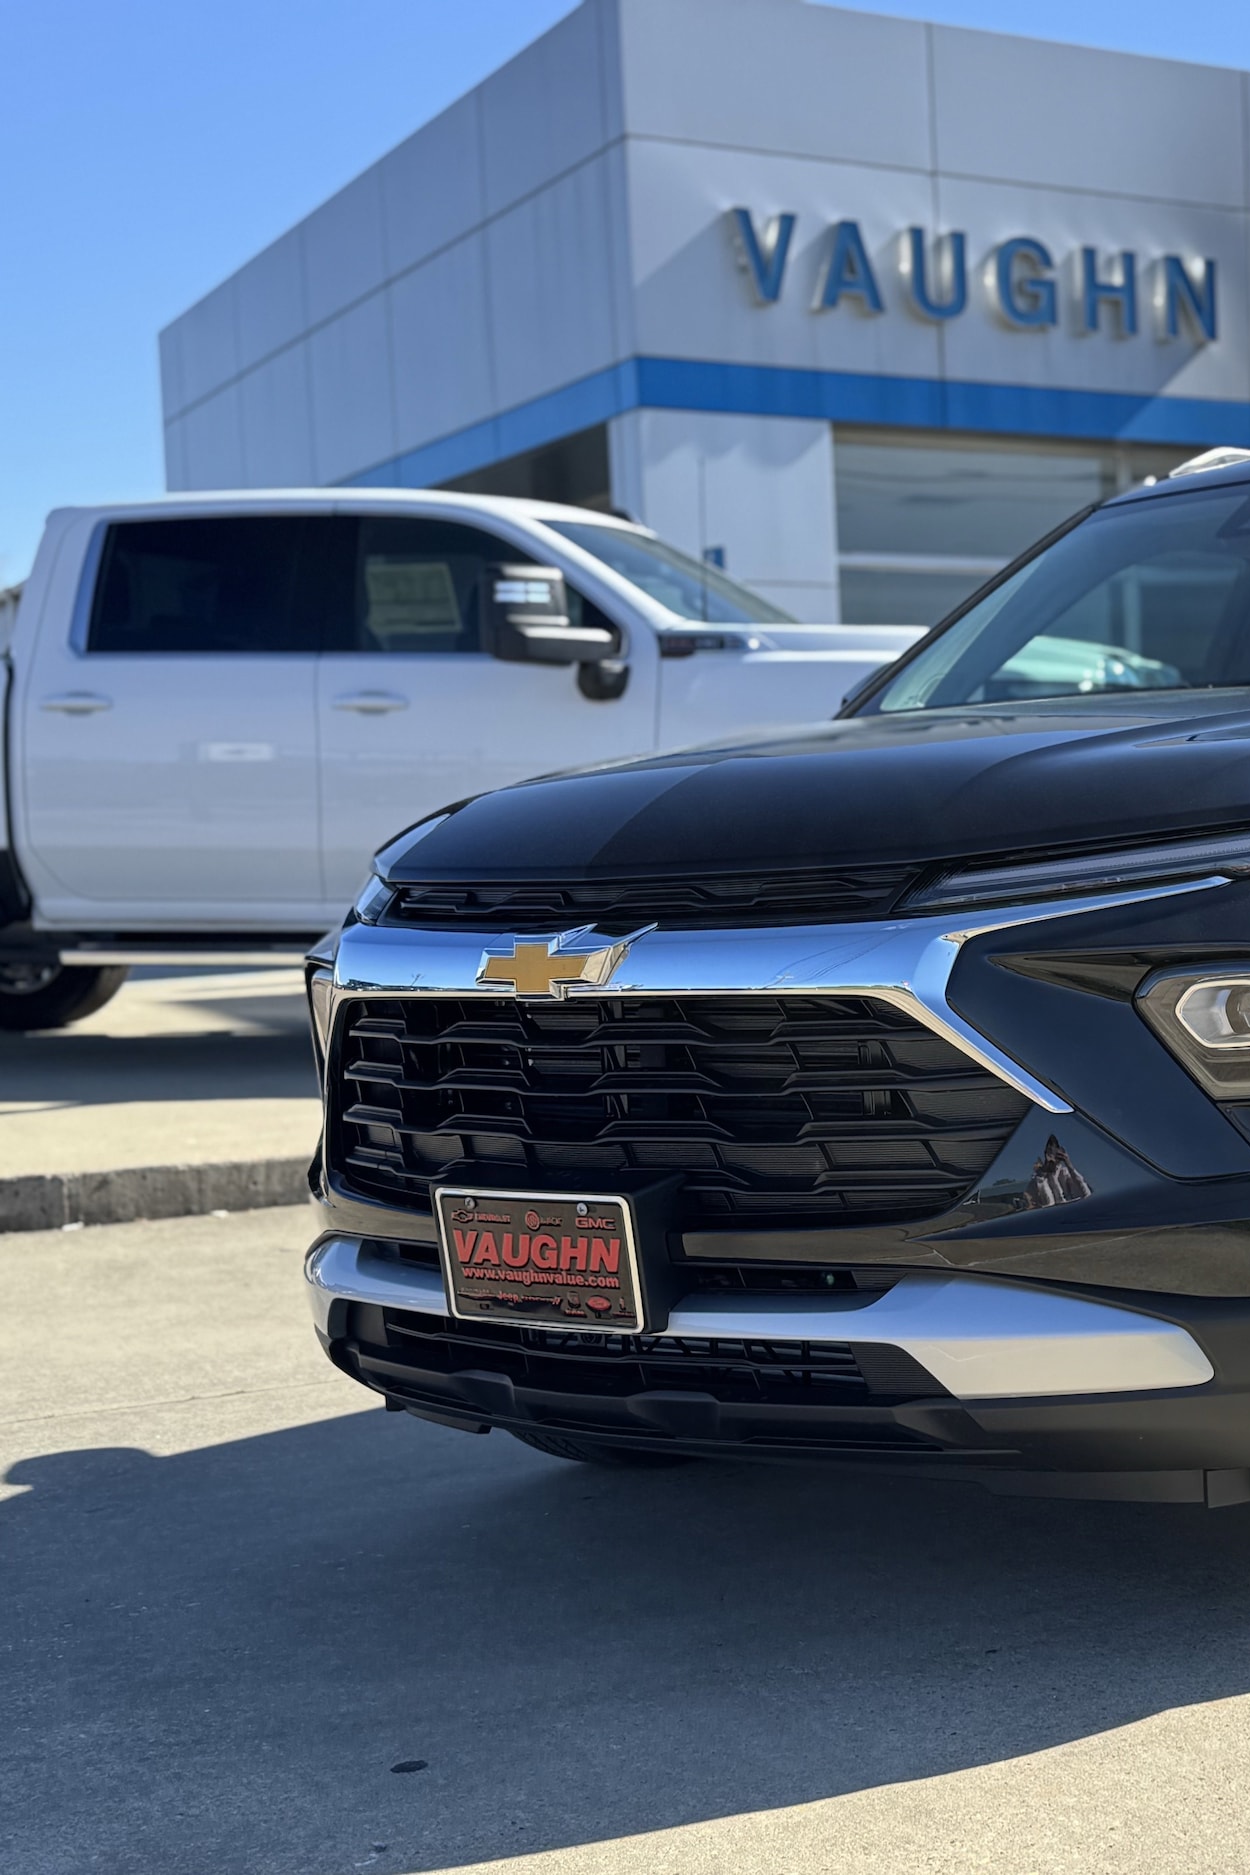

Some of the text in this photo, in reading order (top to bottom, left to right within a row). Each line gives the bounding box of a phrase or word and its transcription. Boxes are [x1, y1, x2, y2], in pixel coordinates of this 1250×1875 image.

[730, 207, 1218, 342] VAUGHN
[575, 1217, 616, 1230] GMC
[452, 1229, 621, 1273] VAUGHN
[461, 1267, 620, 1288] www.vaughnvalue.com
